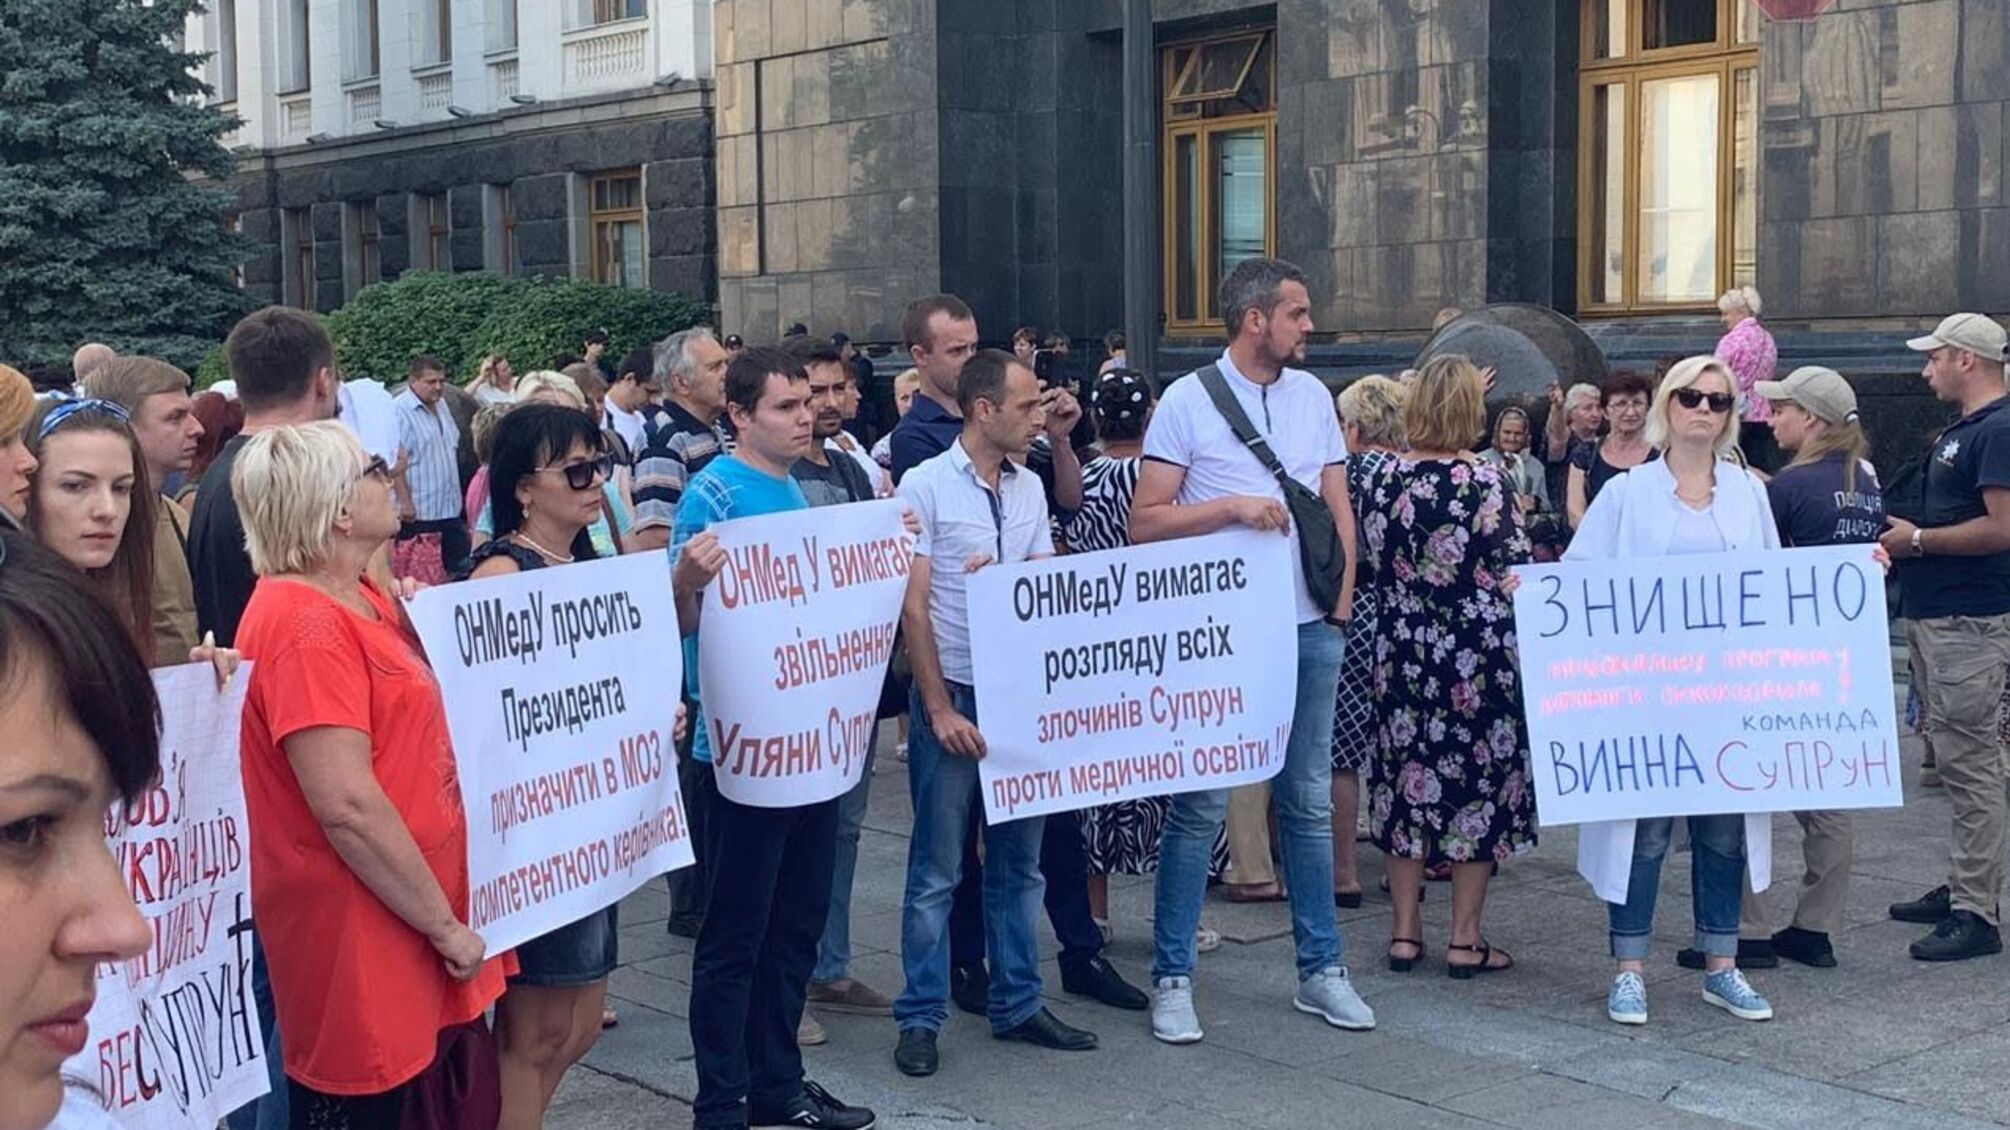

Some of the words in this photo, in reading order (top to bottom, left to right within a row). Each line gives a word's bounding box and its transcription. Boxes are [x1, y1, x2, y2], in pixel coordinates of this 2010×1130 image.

[1013, 562, 1127, 622] ОНМедУ
[1136, 557, 1247, 603] вимагає
[1539, 561, 1867, 637] ЗНИЩЕНО
[454, 591, 543, 668] ОНМедУ
[551, 590, 642, 659] просить
[774, 621, 893, 690] звільнення
[1045, 633, 1167, 694] розгляду
[1177, 616, 1233, 661] всіх
[500, 676, 627, 752] Президента
[714, 717, 821, 778] Уляни
[1038, 692, 1142, 743] злочинів
[1150, 685, 1244, 732] Супрун
[1742, 708, 1879, 733] КОМАНДА
[490, 762, 600, 844] призначити
[603, 757, 618, 794] в
[619, 730, 662, 790] МОЗ
[992, 768, 1063, 815] проти
[1069, 740, 1185, 797] медичної
[1192, 734, 1270, 777] освіти
[1549, 733, 1705, 797] ВИННА
[471, 839, 609, 931] компетентного
[613, 790, 687, 878] керівника!
